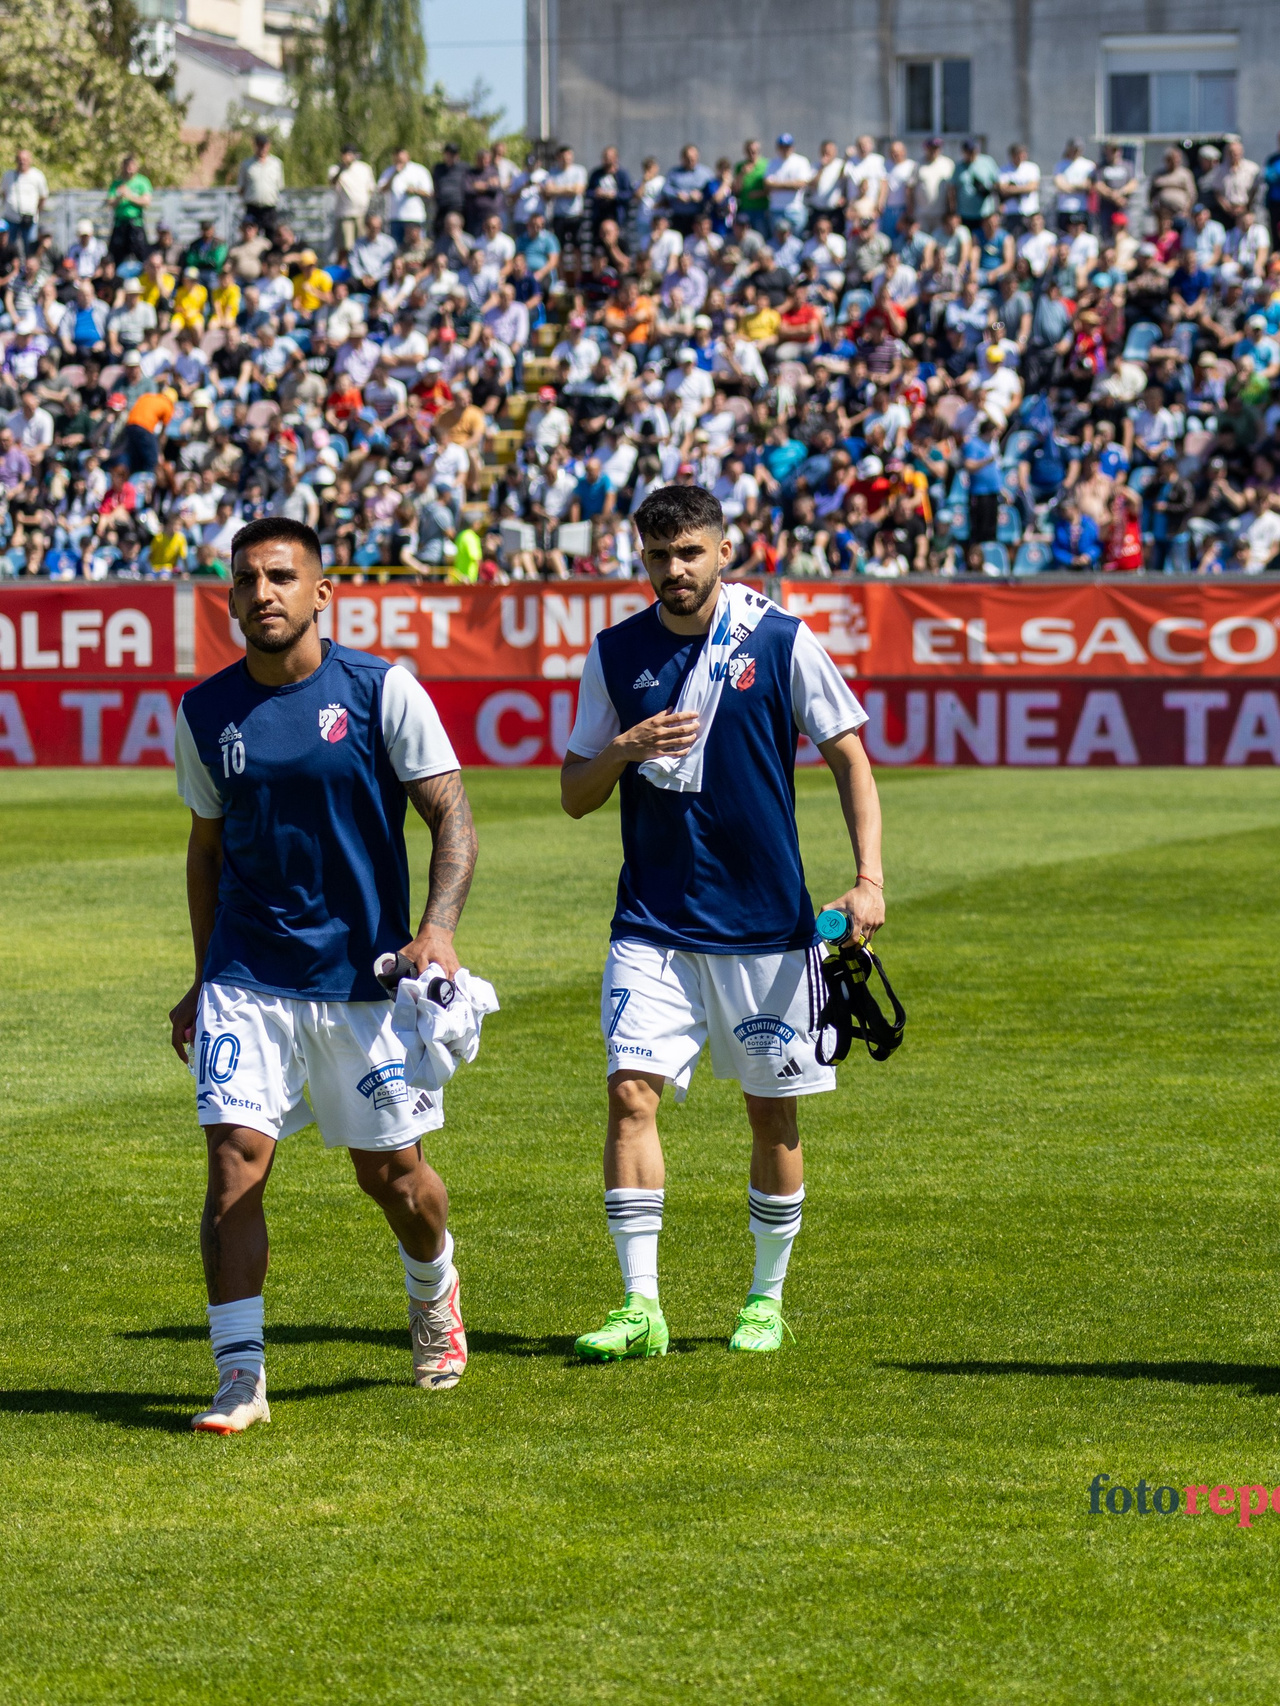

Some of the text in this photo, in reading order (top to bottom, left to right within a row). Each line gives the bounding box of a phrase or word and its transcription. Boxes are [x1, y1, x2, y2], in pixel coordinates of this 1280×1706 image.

[229, 596, 461, 650] IBET
[912, 617, 1279, 665] ELSACO
[633, 679, 660, 690] adidas
[60, 690, 177, 765] TA
[218, 732, 243, 744] adidas
[221, 740, 246, 778] 10
[608, 988, 631, 1039] 7
[746, 1021, 793, 1040] CONTINENTS
[199, 1030, 242, 1085] 10
[614, 1044, 653, 1057] Vestra
[360, 1077, 376, 1094] FIVE
[222, 1095, 263, 1112] Vestra
